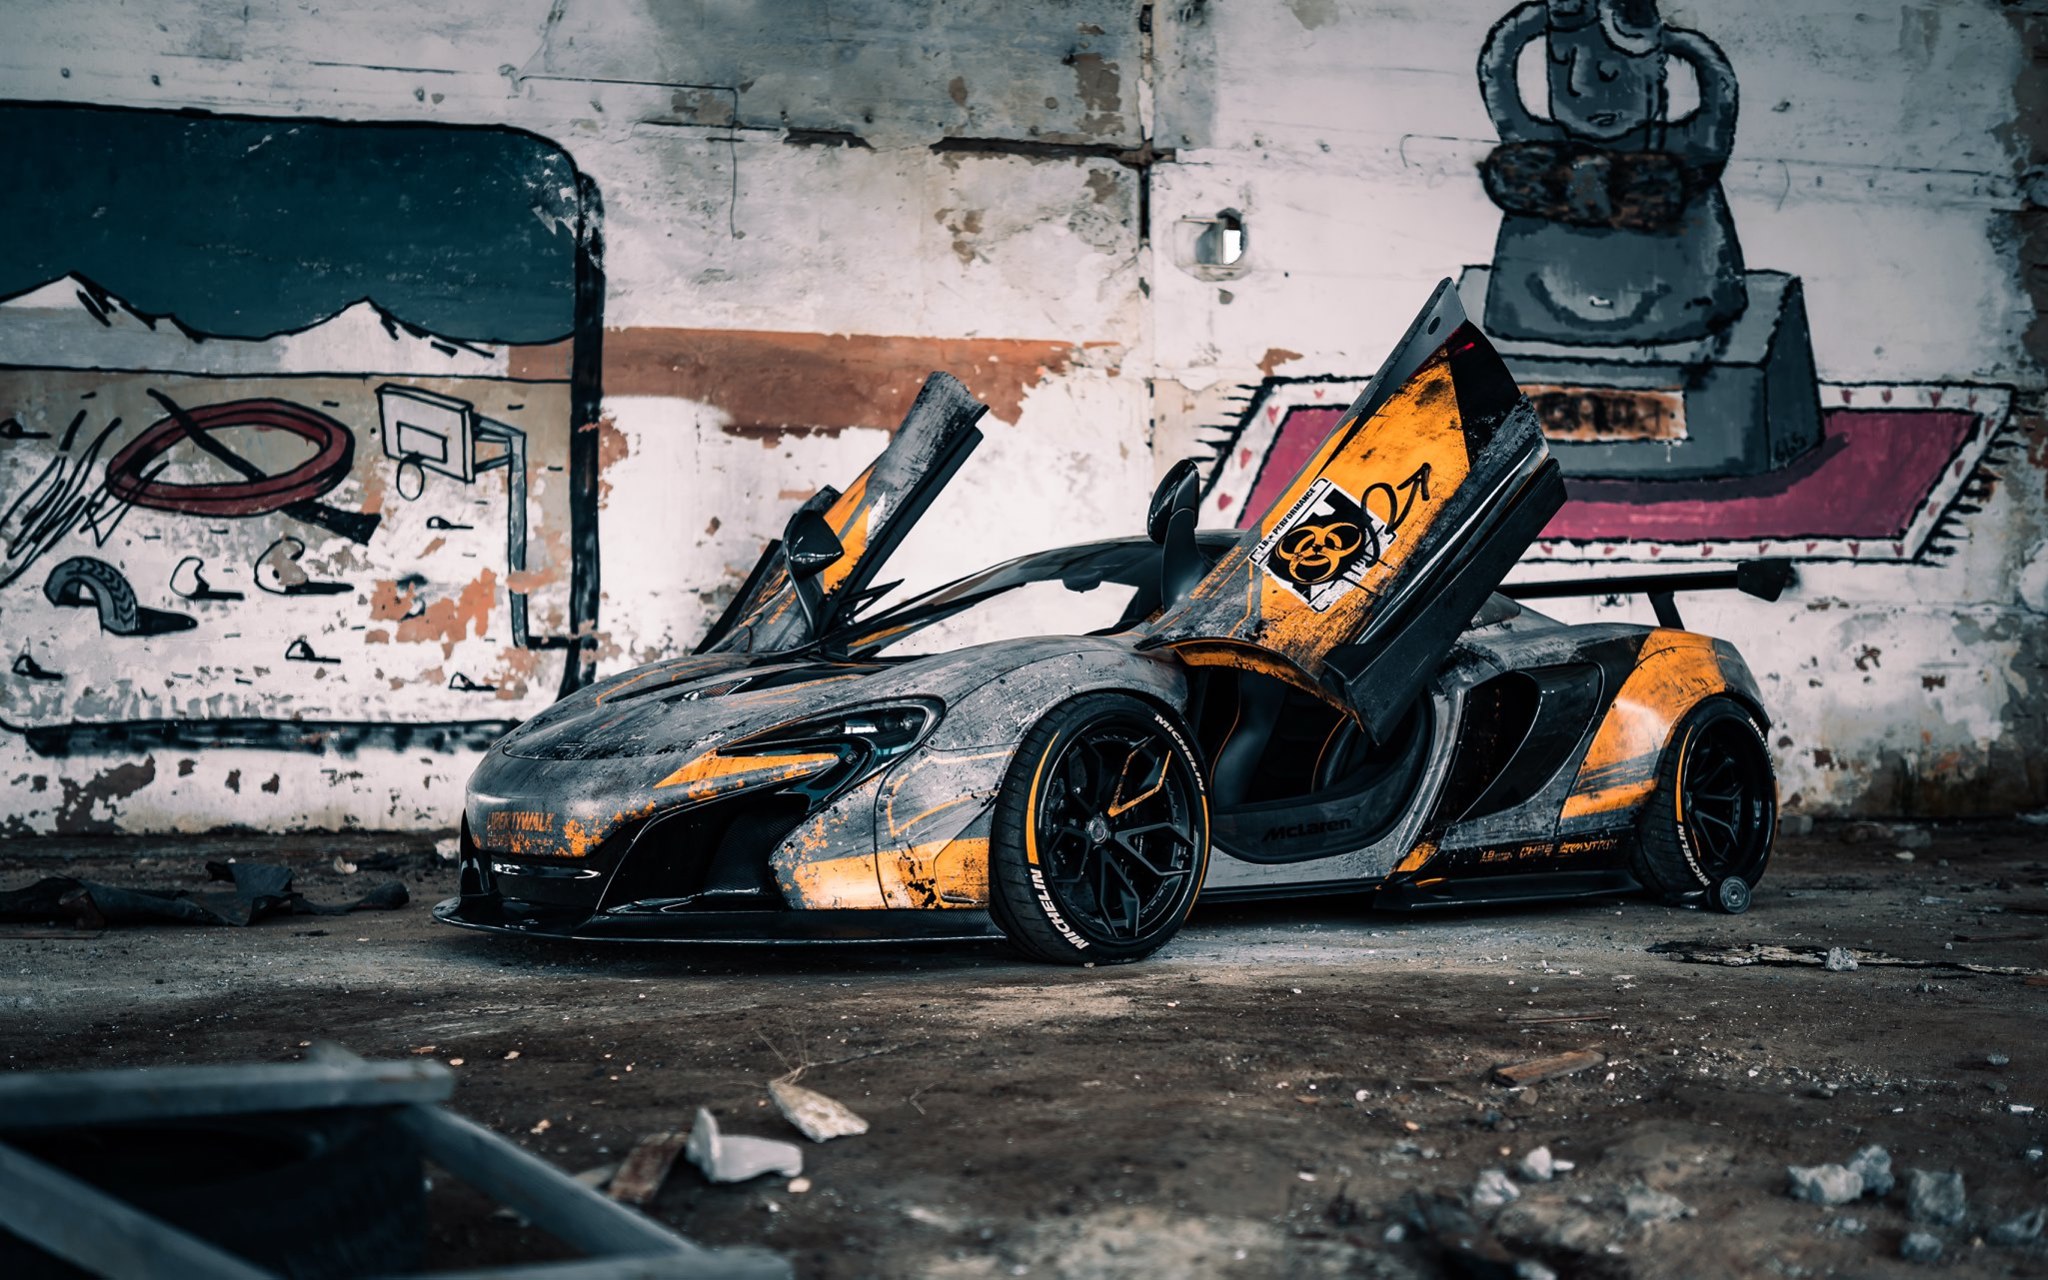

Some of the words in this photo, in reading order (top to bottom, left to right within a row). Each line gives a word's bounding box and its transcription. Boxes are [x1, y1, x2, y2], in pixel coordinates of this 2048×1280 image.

[1272, 487, 1316, 535] PERFORMANCE
[1154, 713, 1205, 791] MICHELIN
[1261, 818, 1353, 842] McLaren
[1677, 824, 1711, 887] MICHELIN
[1030, 868, 1090, 950] MICHELIN
